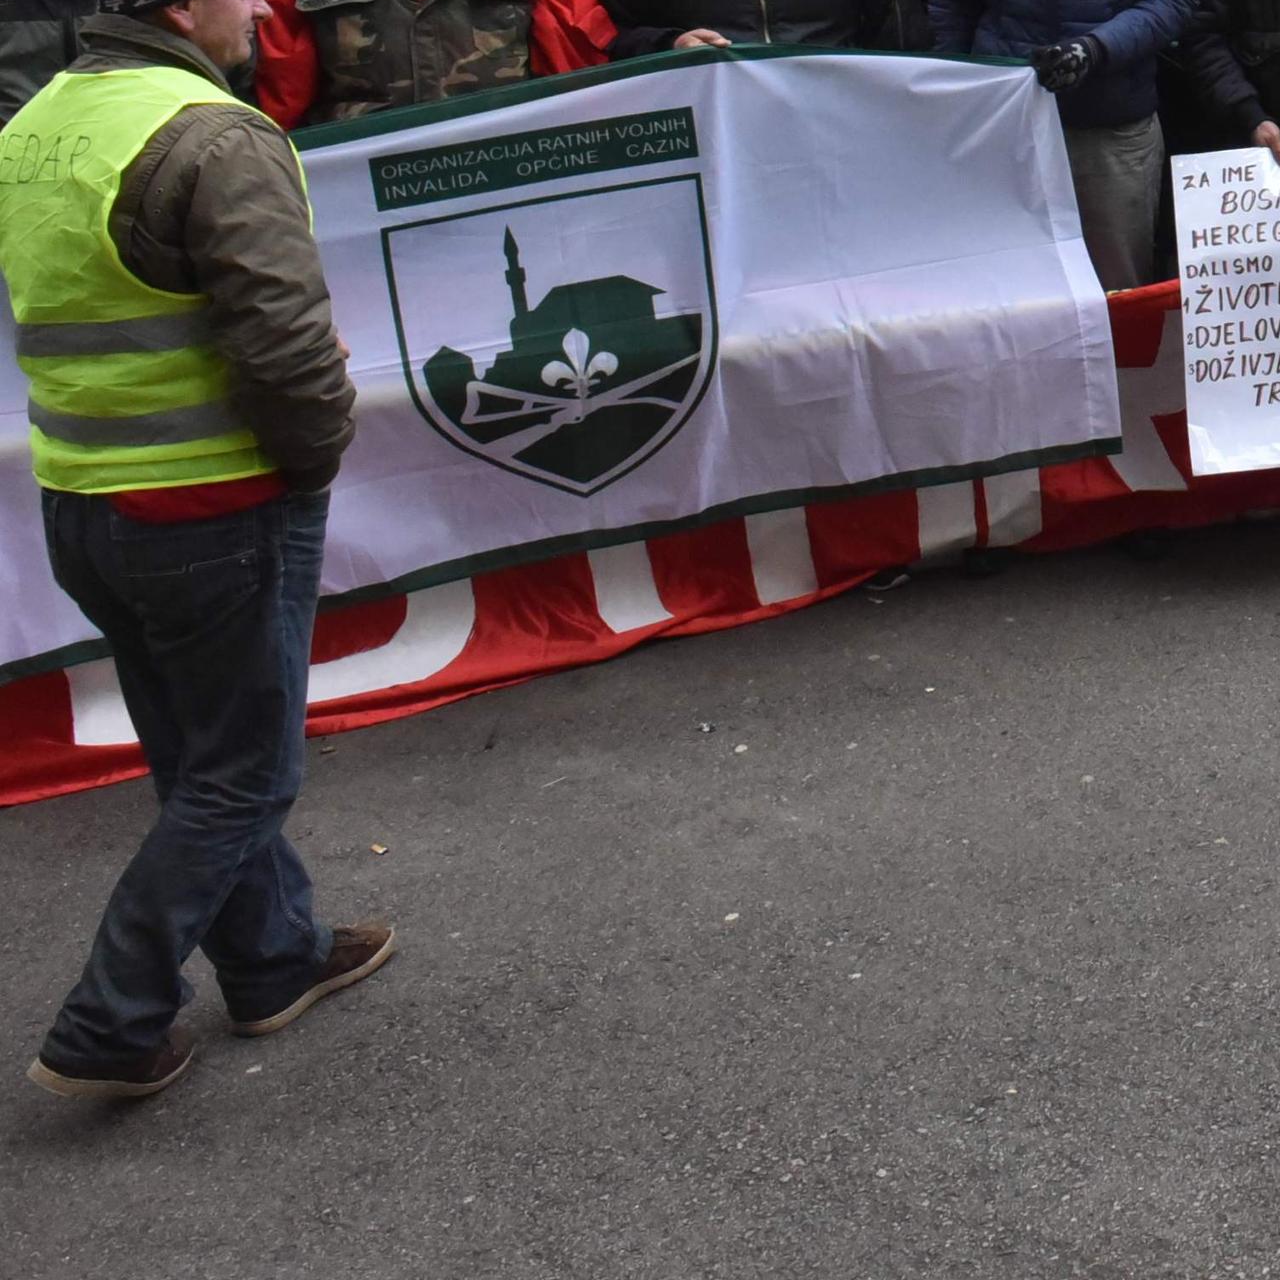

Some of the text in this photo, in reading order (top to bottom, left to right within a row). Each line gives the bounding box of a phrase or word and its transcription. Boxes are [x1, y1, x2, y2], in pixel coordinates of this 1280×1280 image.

[381, 117, 687, 180] ORGANIZACIJA RATNIH VOJNIH
[384, 170, 489, 201] INVALIDA
[626, 136, 690, 158] CAZIN
[1182, 164, 1257, 190] ZA IME
